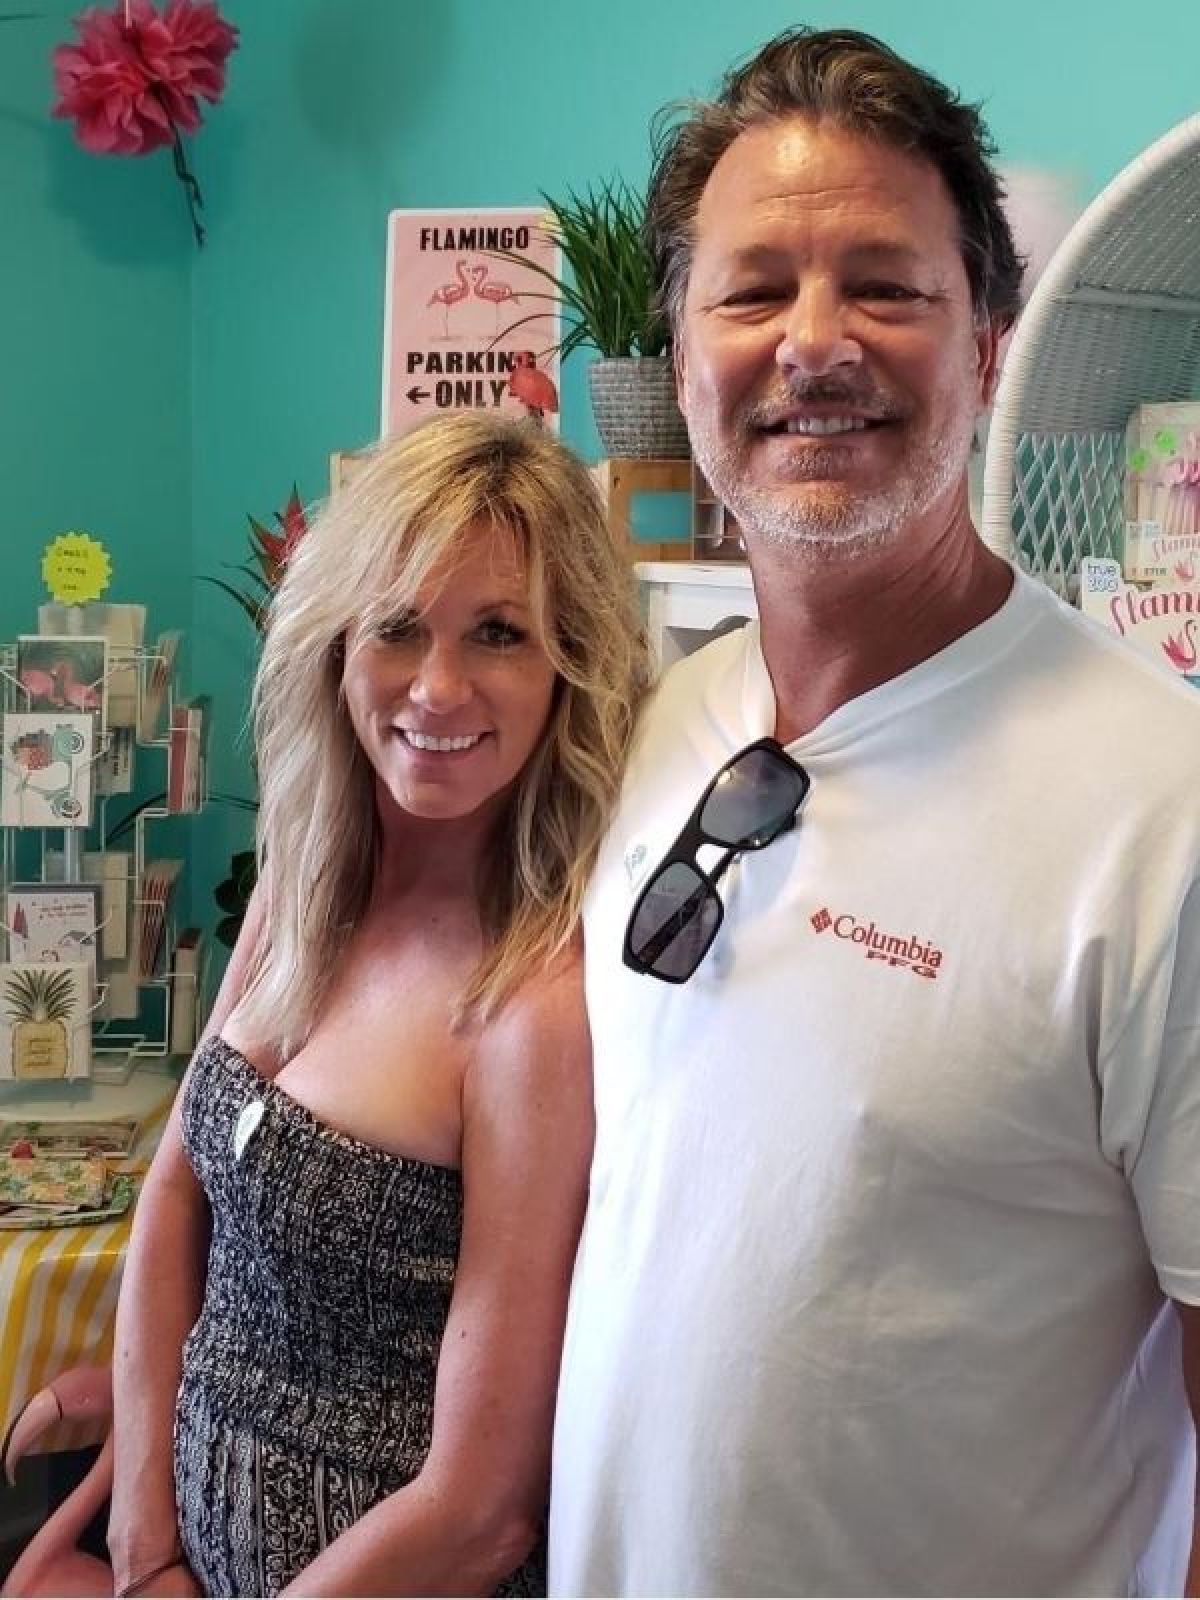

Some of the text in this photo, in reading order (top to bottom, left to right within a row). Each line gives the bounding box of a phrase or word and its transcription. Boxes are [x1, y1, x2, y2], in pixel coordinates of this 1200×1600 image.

[419, 226, 530, 251] FLAMINGO
[435, 379, 508, 408] ONLY
[833, 914, 943, 967] Columbia
